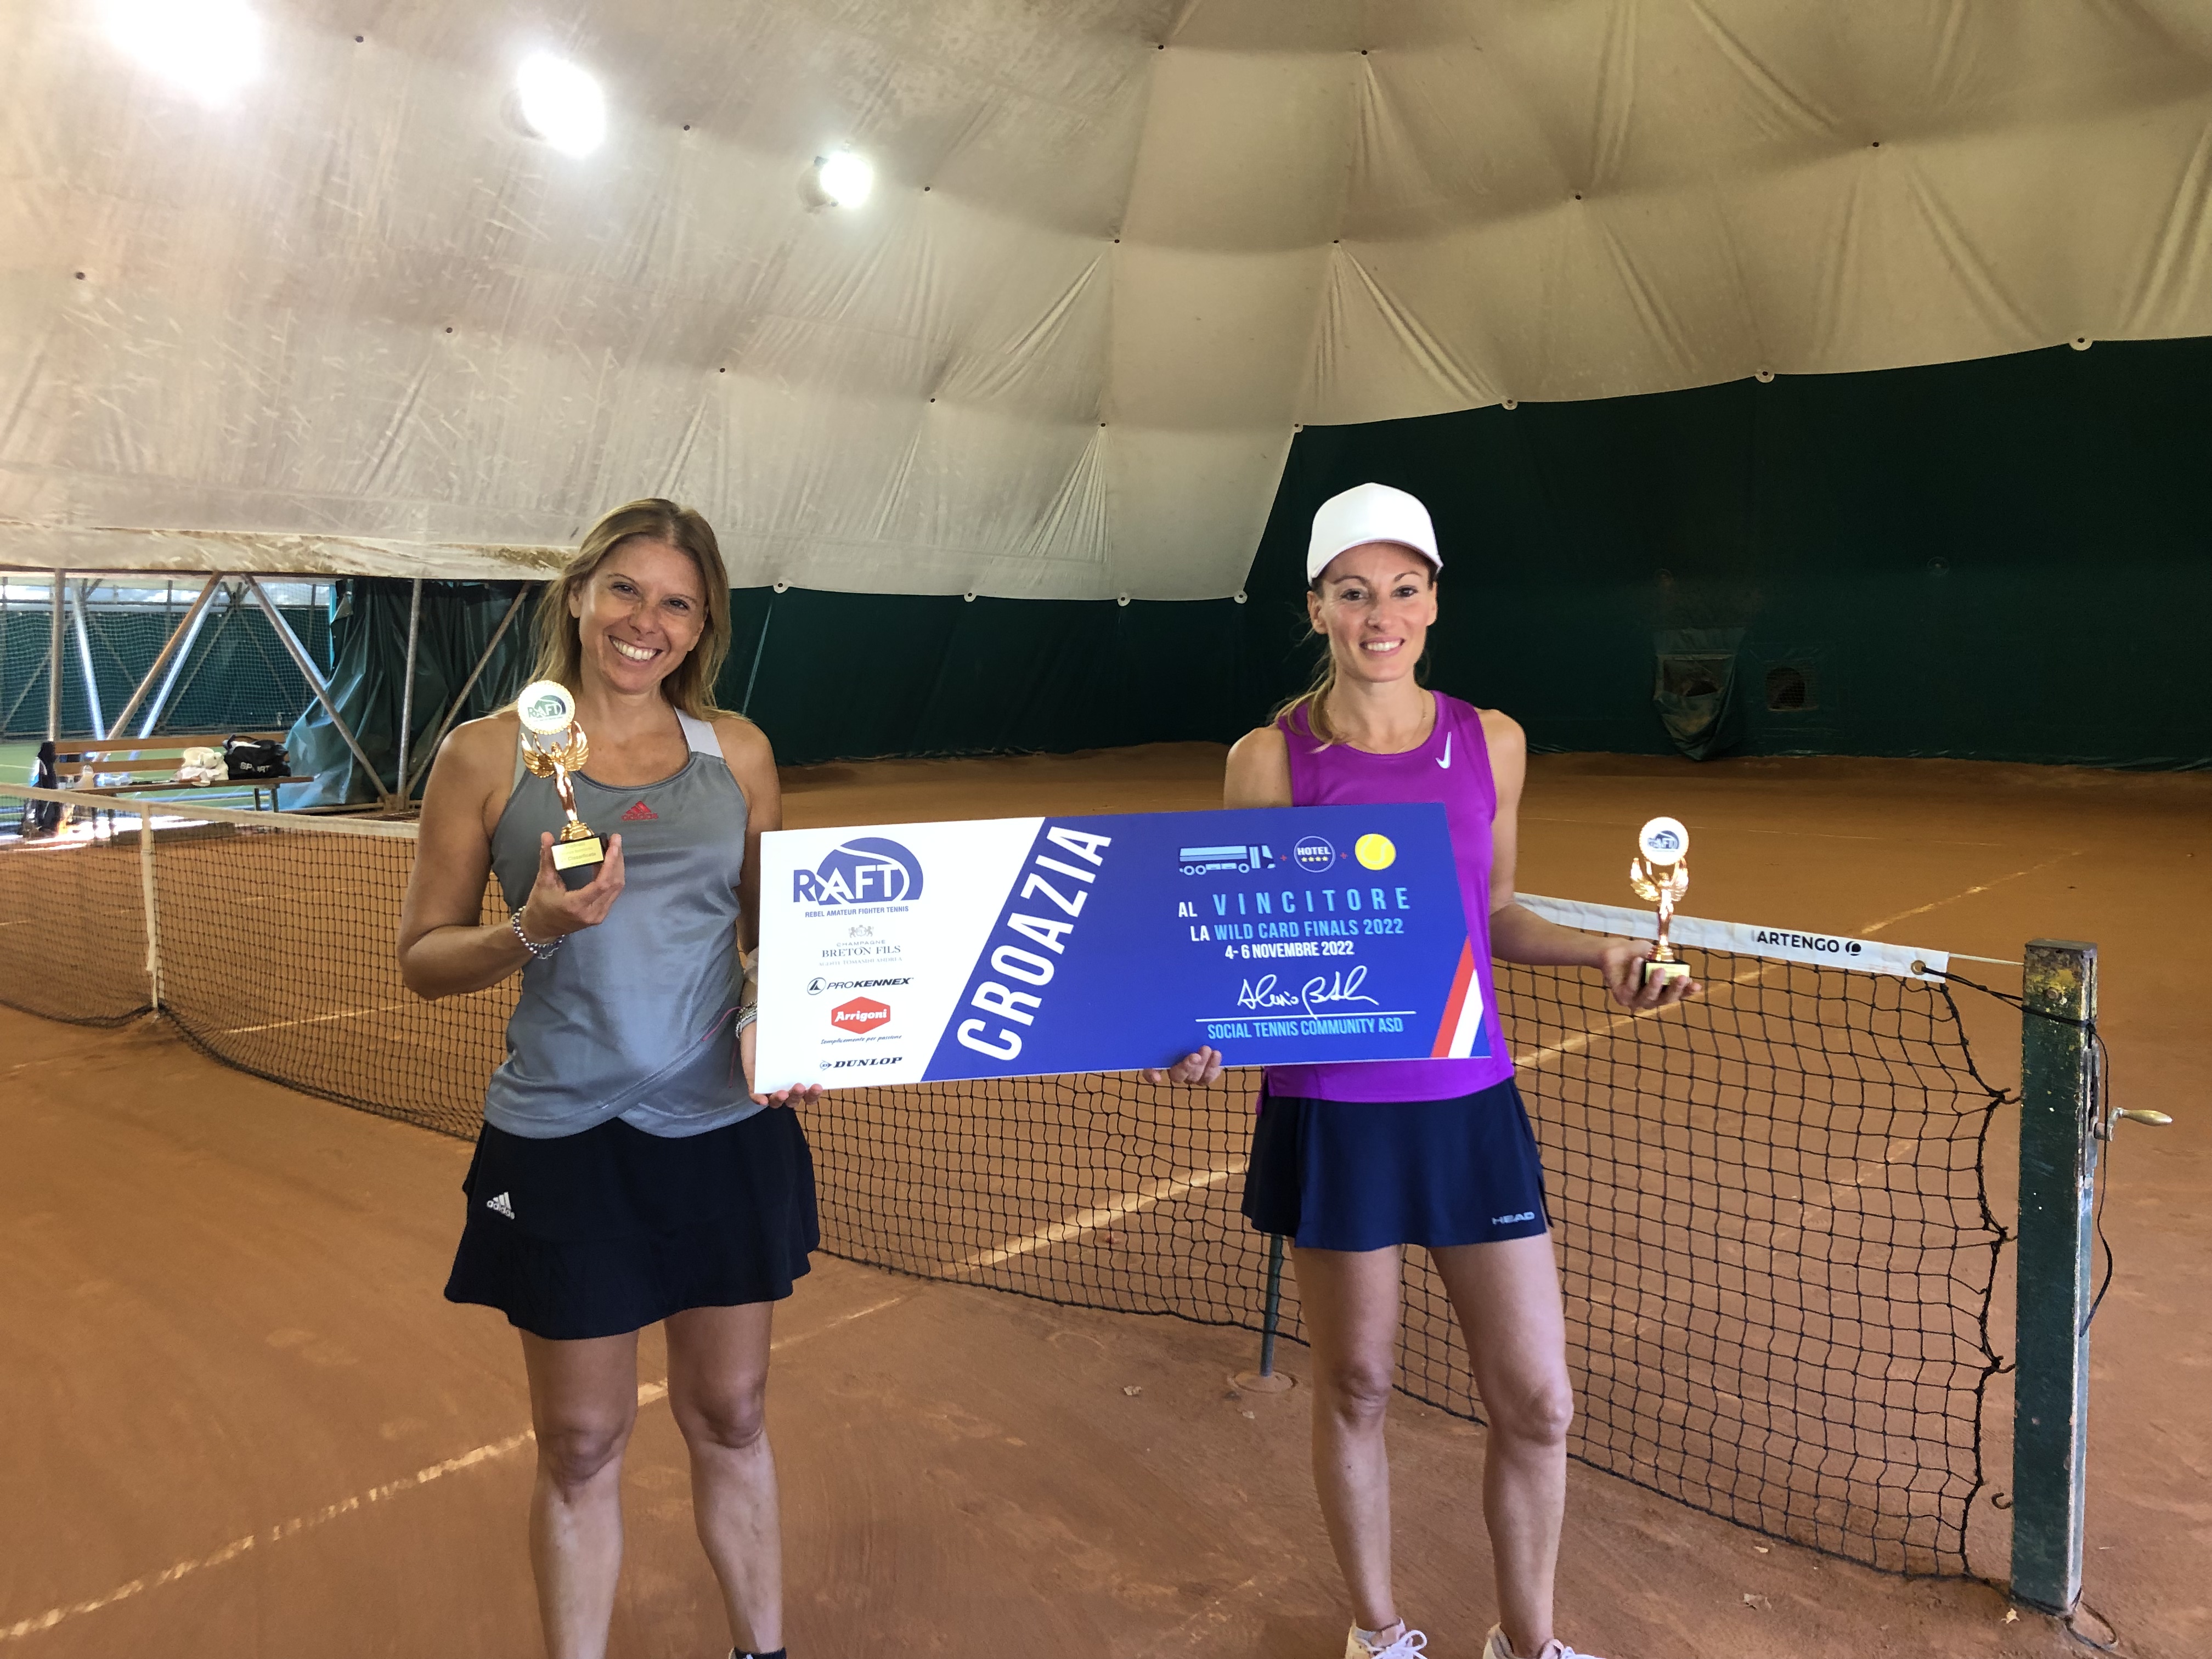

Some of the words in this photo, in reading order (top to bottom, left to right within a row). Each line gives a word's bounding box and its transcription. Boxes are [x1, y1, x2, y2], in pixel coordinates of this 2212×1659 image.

[621, 812, 659, 821] adidas
[1297, 846, 1331, 856] HOTEL
[1178, 901, 1198, 917] AL
[1212, 887, 1410, 916] VINCITORE
[827, 909, 856, 917] AMATEUR
[1190, 925, 1210, 941] LA
[1214, 923, 1254, 940] WILD
[1258, 922, 1300, 939] CARD
[1305, 919, 1358, 937] FINALS
[1363, 918, 1404, 935] 2022
[957, 826, 1111, 1060] CROAZIA
[1757, 931, 1839, 953] ARTENGO
[822, 947, 871, 957] BRETON
[876, 945, 901, 954] FILS
[1252, 941, 1320, 958] NOVEMBRE
[1322, 940, 1355, 955] 2022
[827, 978, 912, 990] PROKENNEX
[834, 1008, 887, 1023] Arrigoni
[1207, 1023, 1252, 1039] SOCIAL
[1253, 1021, 1299, 1037] TENNIS
[1301, 1018, 1375, 1035] COMMUNITY
[1378, 1017, 1403, 1032] ASD
[821, 1037, 865, 1045] Semplicemente
[833, 1057, 902, 1068] DUNLOP
[1492, 1211, 1535, 1224] HEAD
